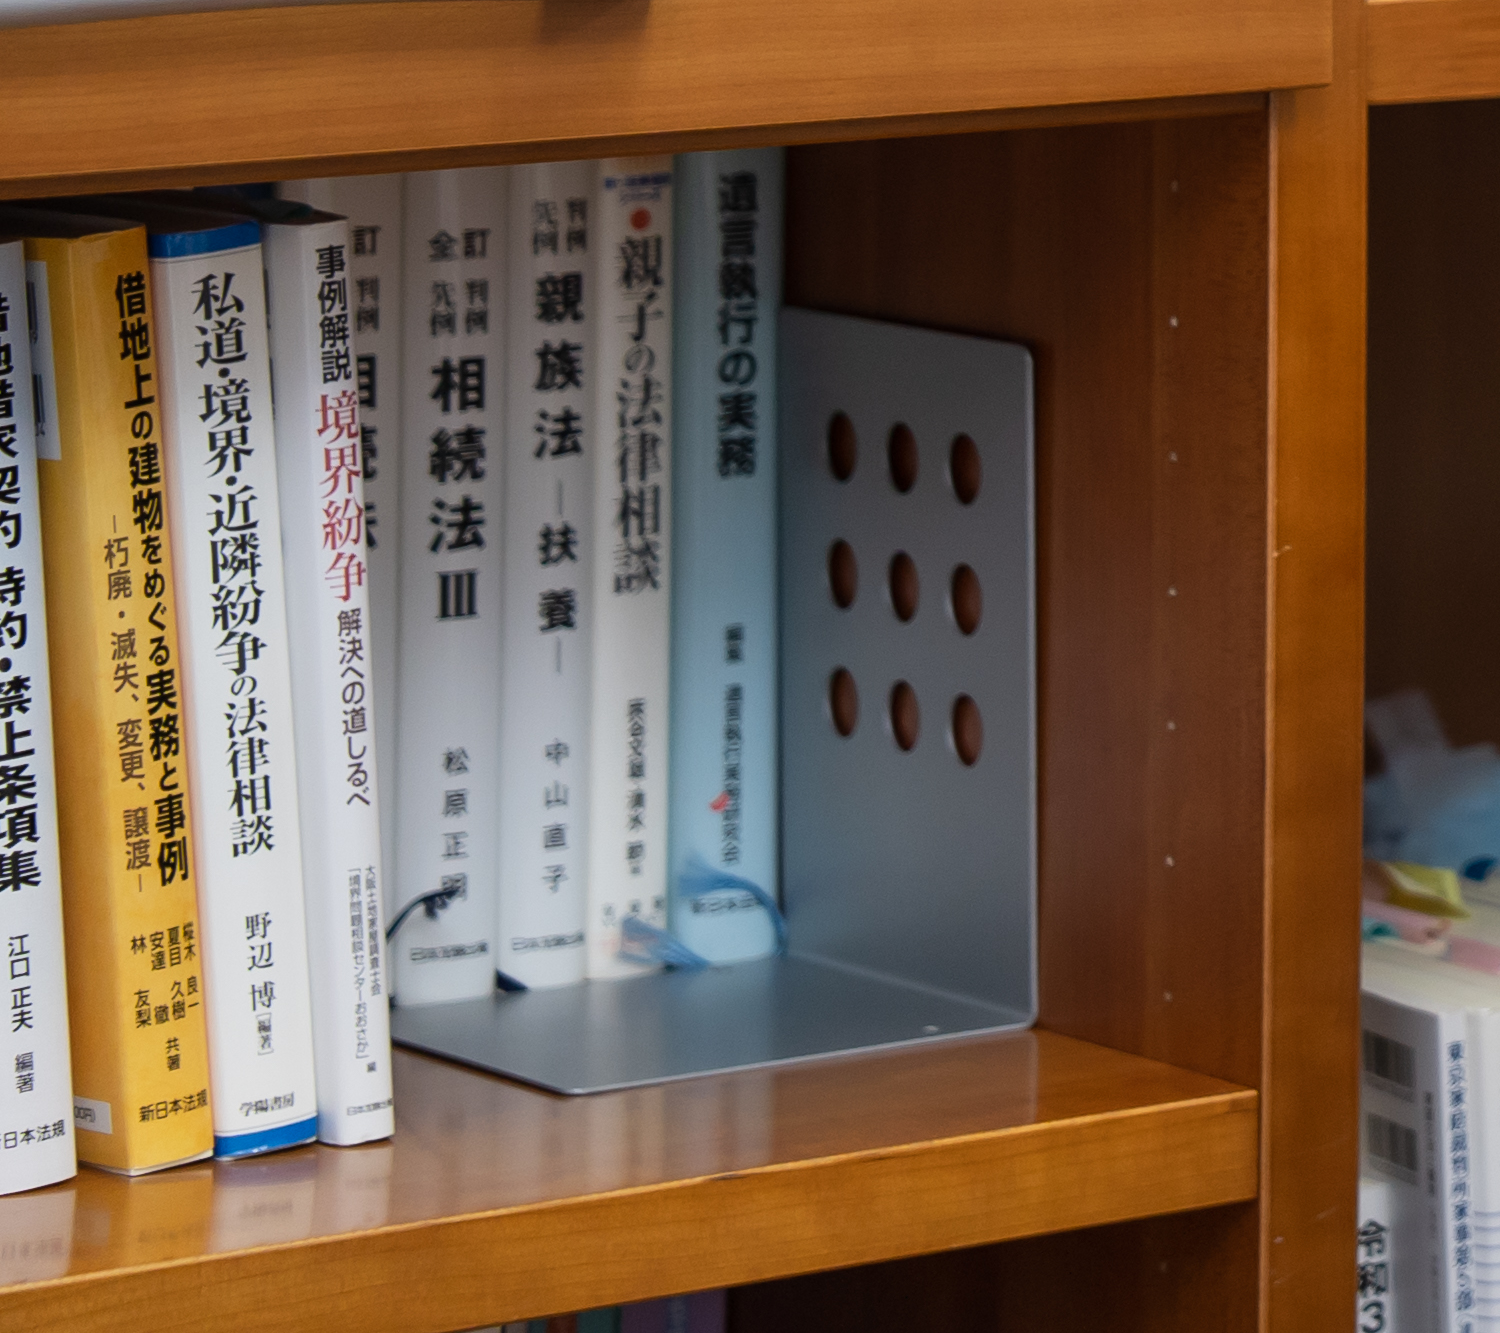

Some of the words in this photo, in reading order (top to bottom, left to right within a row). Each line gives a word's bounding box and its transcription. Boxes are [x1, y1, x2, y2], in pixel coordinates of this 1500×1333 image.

[353, 225, 381, 257] 訂
[428, 228, 490, 264] 全訂
[315, 244, 353, 384] 事例解説
[716, 170, 758, 479] 遺言執行の実務
[612, 235, 664, 595] 親子の法律相談
[315, 389, 368, 603] 境界紛争
[115, 271, 189, 887] 借地上の建物をめぐる実務と事例
[190, 271, 276, 859] 私道・境界・近隣紛争の法律相談
[336, 607, 372, 809] 解決への道しるべ
[542, 737, 571, 893] 中山直子
[130, 935, 148, 955] 林
[149, 931, 166, 972] 安達
[167, 926, 183, 967] 夏目
[244, 911, 275, 972] 野辺
[250, 981, 276, 1012] 博
[15, 1051, 35, 1094] 編著
[165, 1036, 181, 1072] 共著
[138, 1088, 209, 1124] 新日本法規
[0, 1119, 66, 1149] 日本法規
